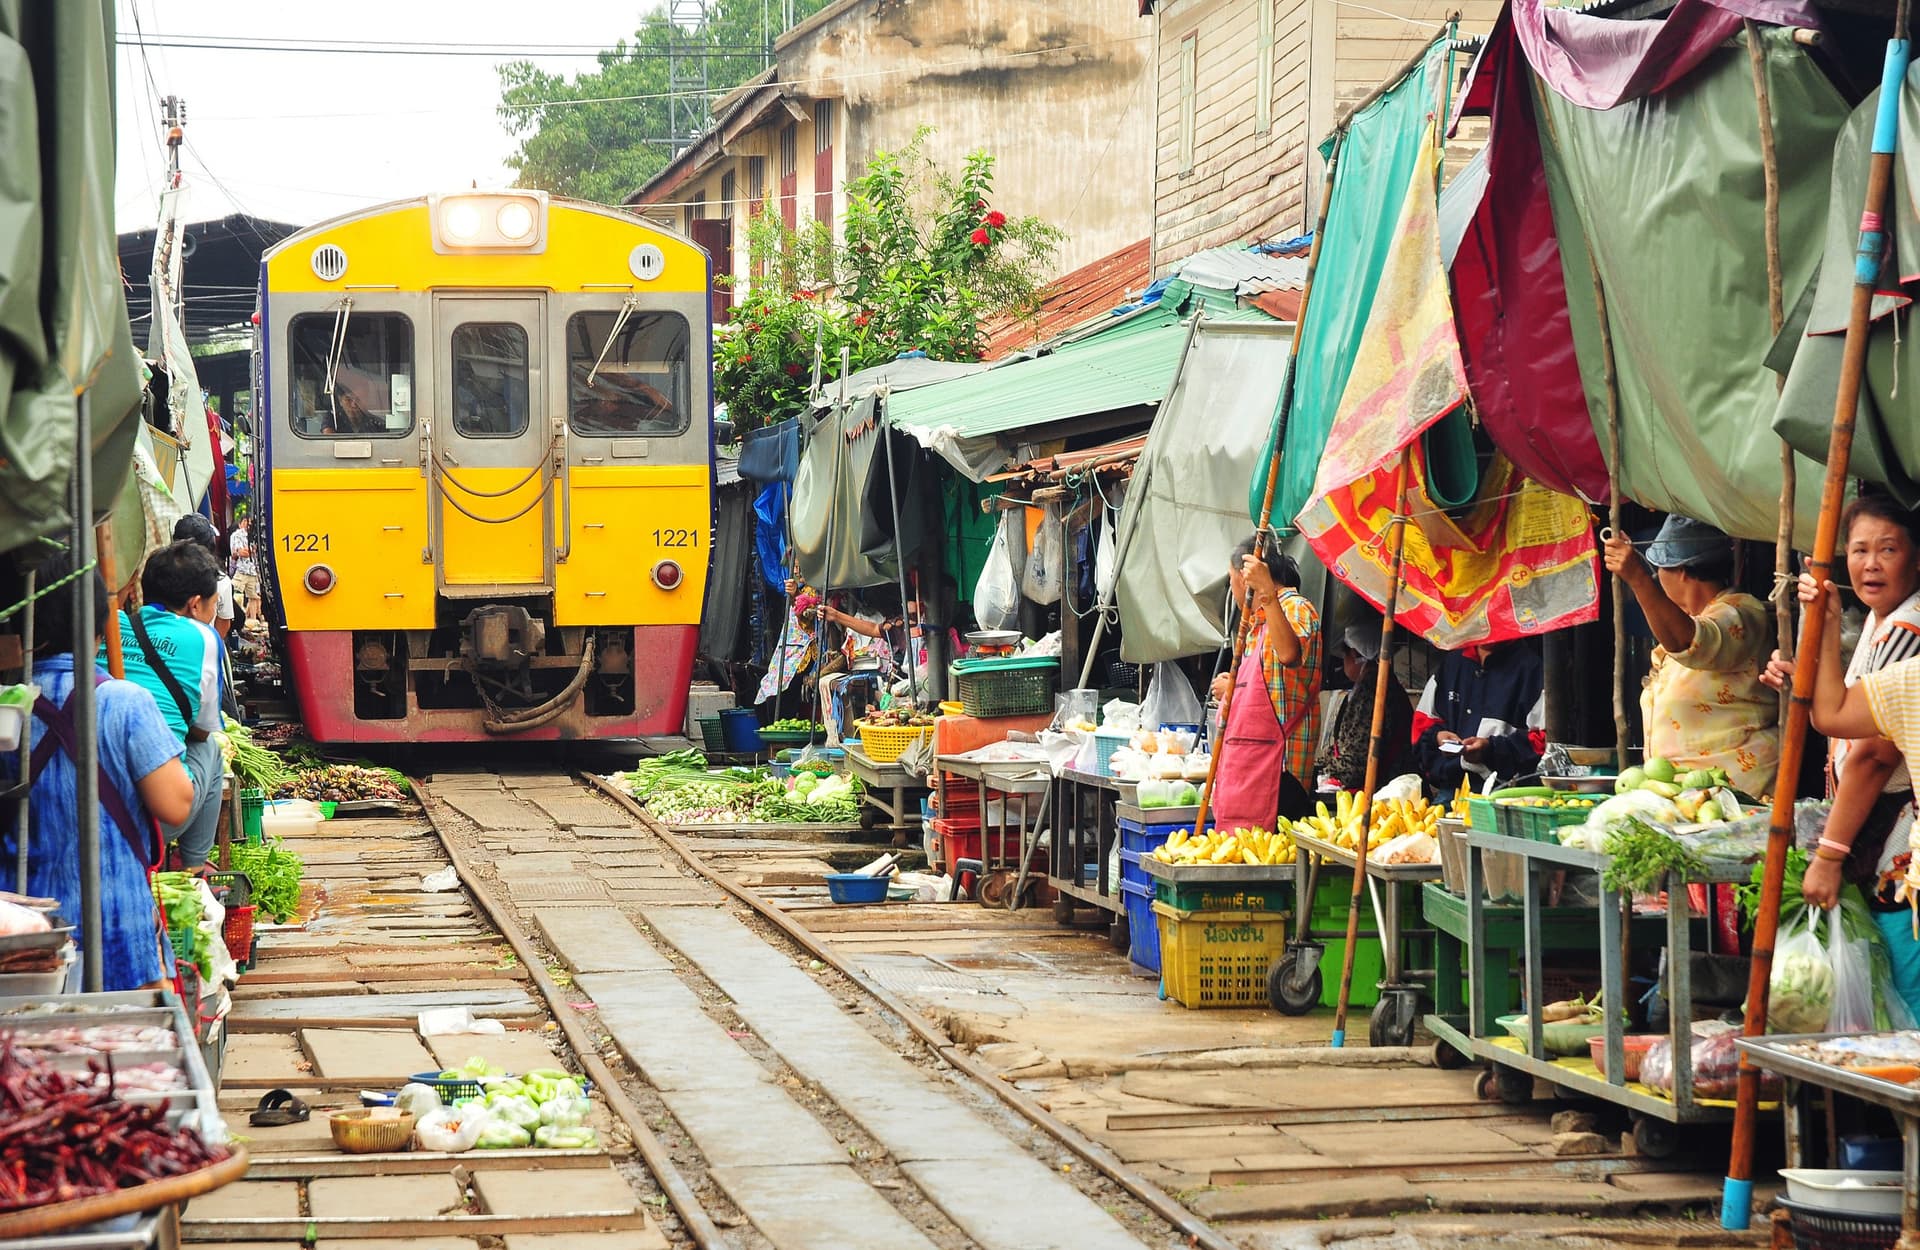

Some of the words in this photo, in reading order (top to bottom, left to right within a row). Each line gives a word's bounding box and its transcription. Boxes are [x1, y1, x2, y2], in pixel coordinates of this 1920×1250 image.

[281, 533, 330, 553] 1221
[652, 529, 698, 547] 1221
[1511, 569, 1528, 582] CP
